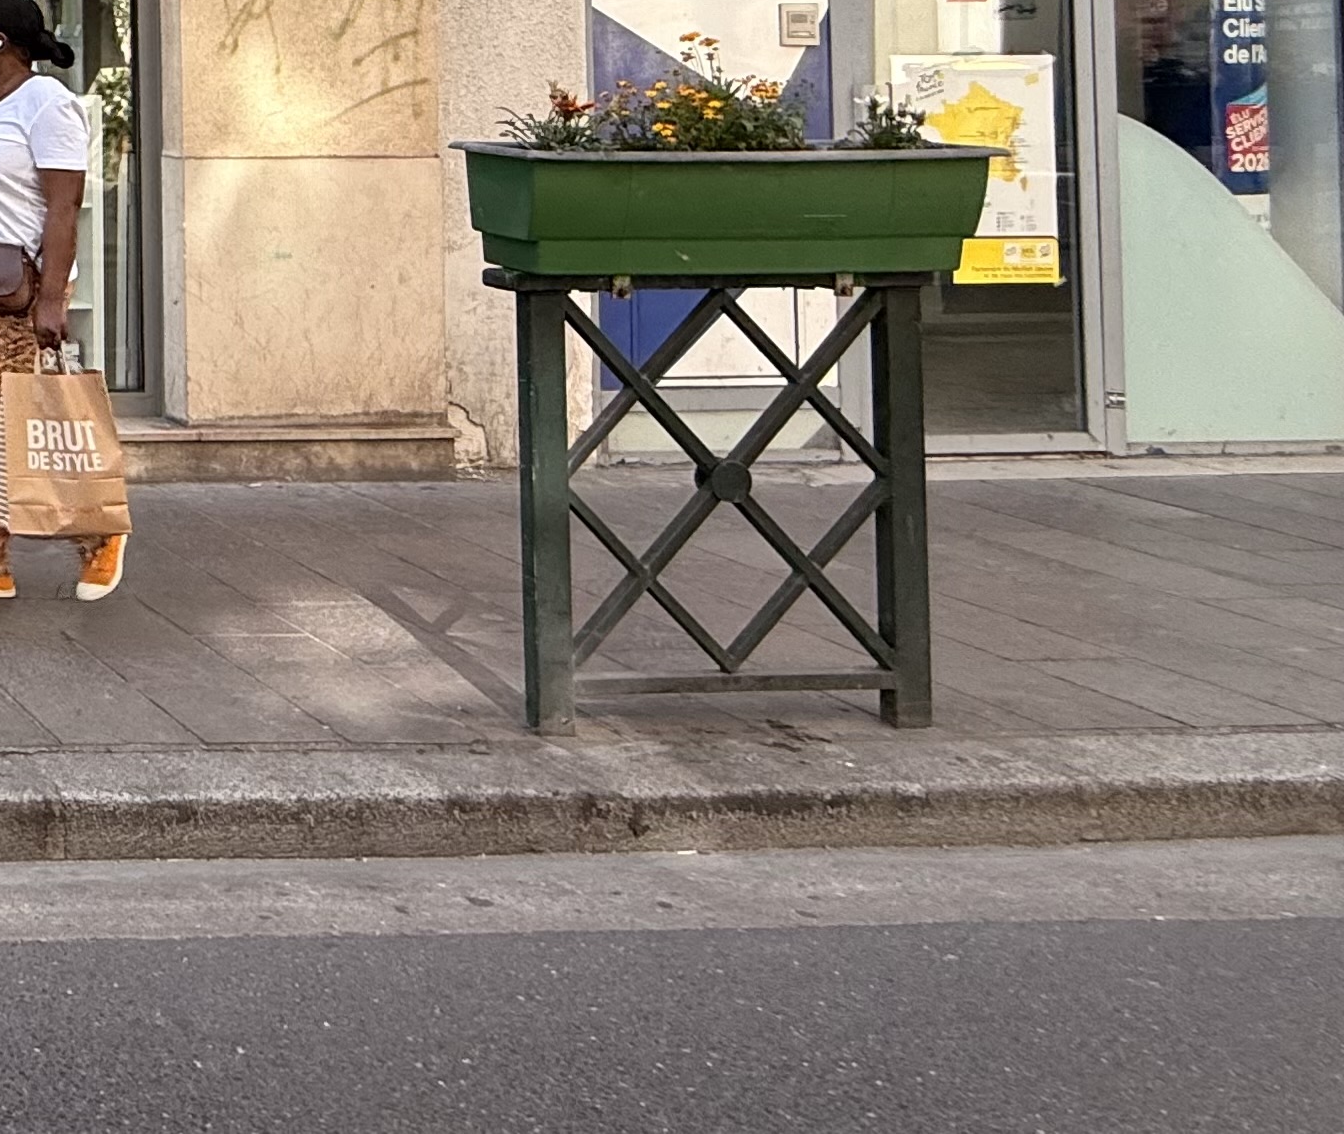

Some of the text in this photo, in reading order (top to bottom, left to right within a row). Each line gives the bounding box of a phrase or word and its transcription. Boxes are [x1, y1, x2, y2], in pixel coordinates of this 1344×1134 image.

[1224, 44, 1250, 64] de
[26, 419, 96, 451] BRUT
[27, 451, 104, 472] DE STYLE
